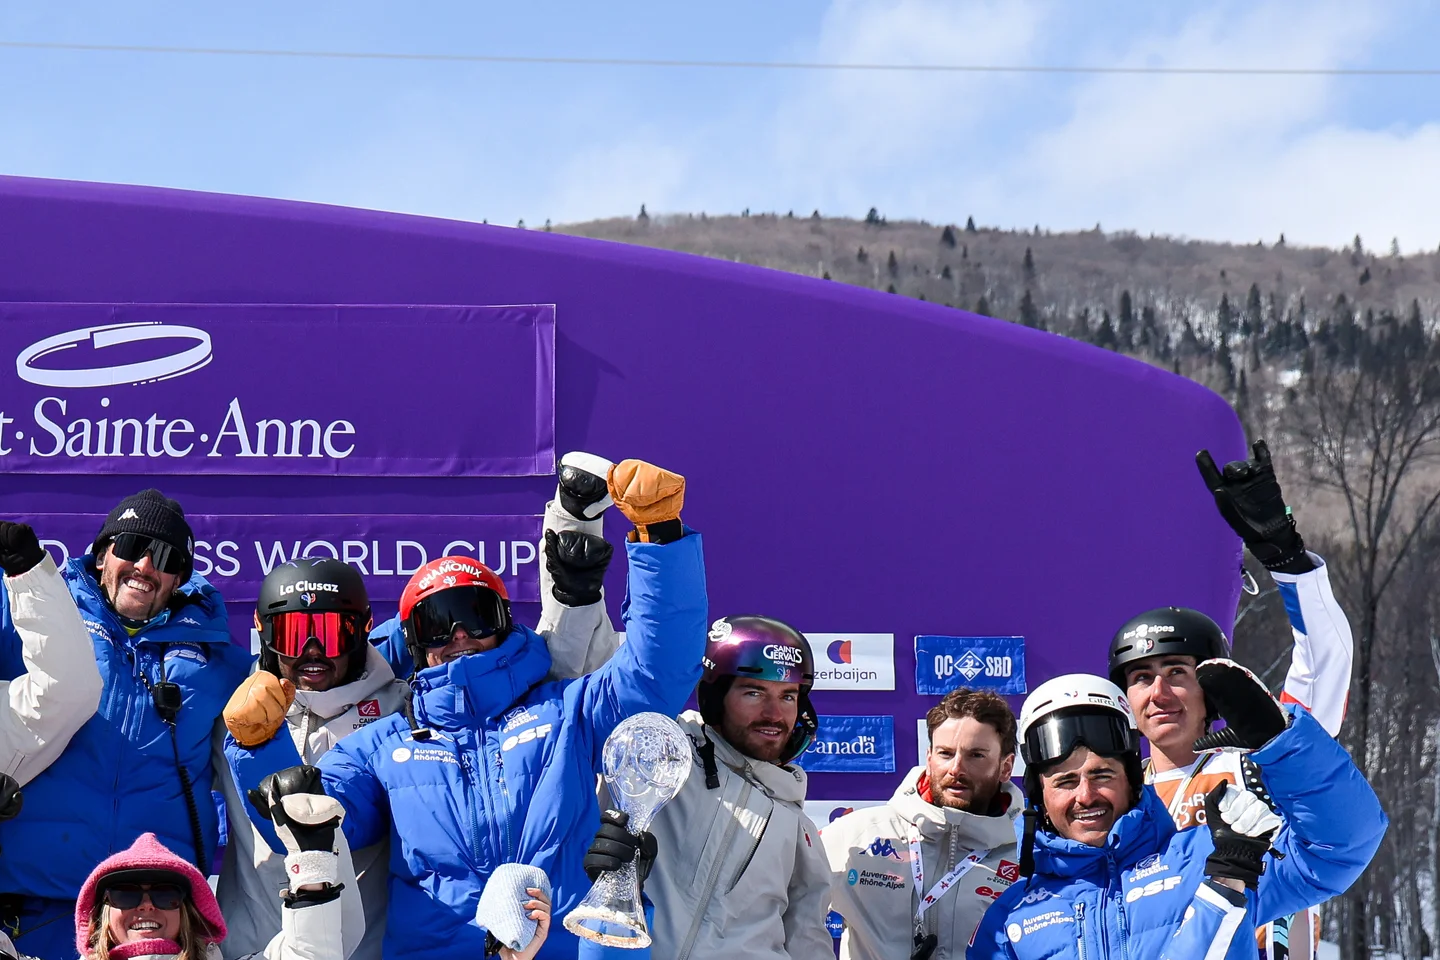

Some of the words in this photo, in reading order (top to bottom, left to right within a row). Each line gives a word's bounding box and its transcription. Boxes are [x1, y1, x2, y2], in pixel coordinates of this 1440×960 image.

[418, 562, 483, 590] CHAMONIX
[280, 584, 294, 596] La
[295, 580, 339, 594] Clusaz
[1148, 624, 1175, 634] alpes
[813, 667, 878, 683] zerbaijan
[934, 655, 954, 679] QC
[985, 656, 1011, 678] SBD
[1088, 697, 1116, 707] GIRO
[413, 755, 461, 768] Rhône-Alp
[859, 877, 905, 890] Rhône-Alpes
[860, 869, 900, 882] Auvergne-
[1022, 910, 1065, 928] Auvergne-
[1023, 915, 1074, 936] Rhône-Alpes
